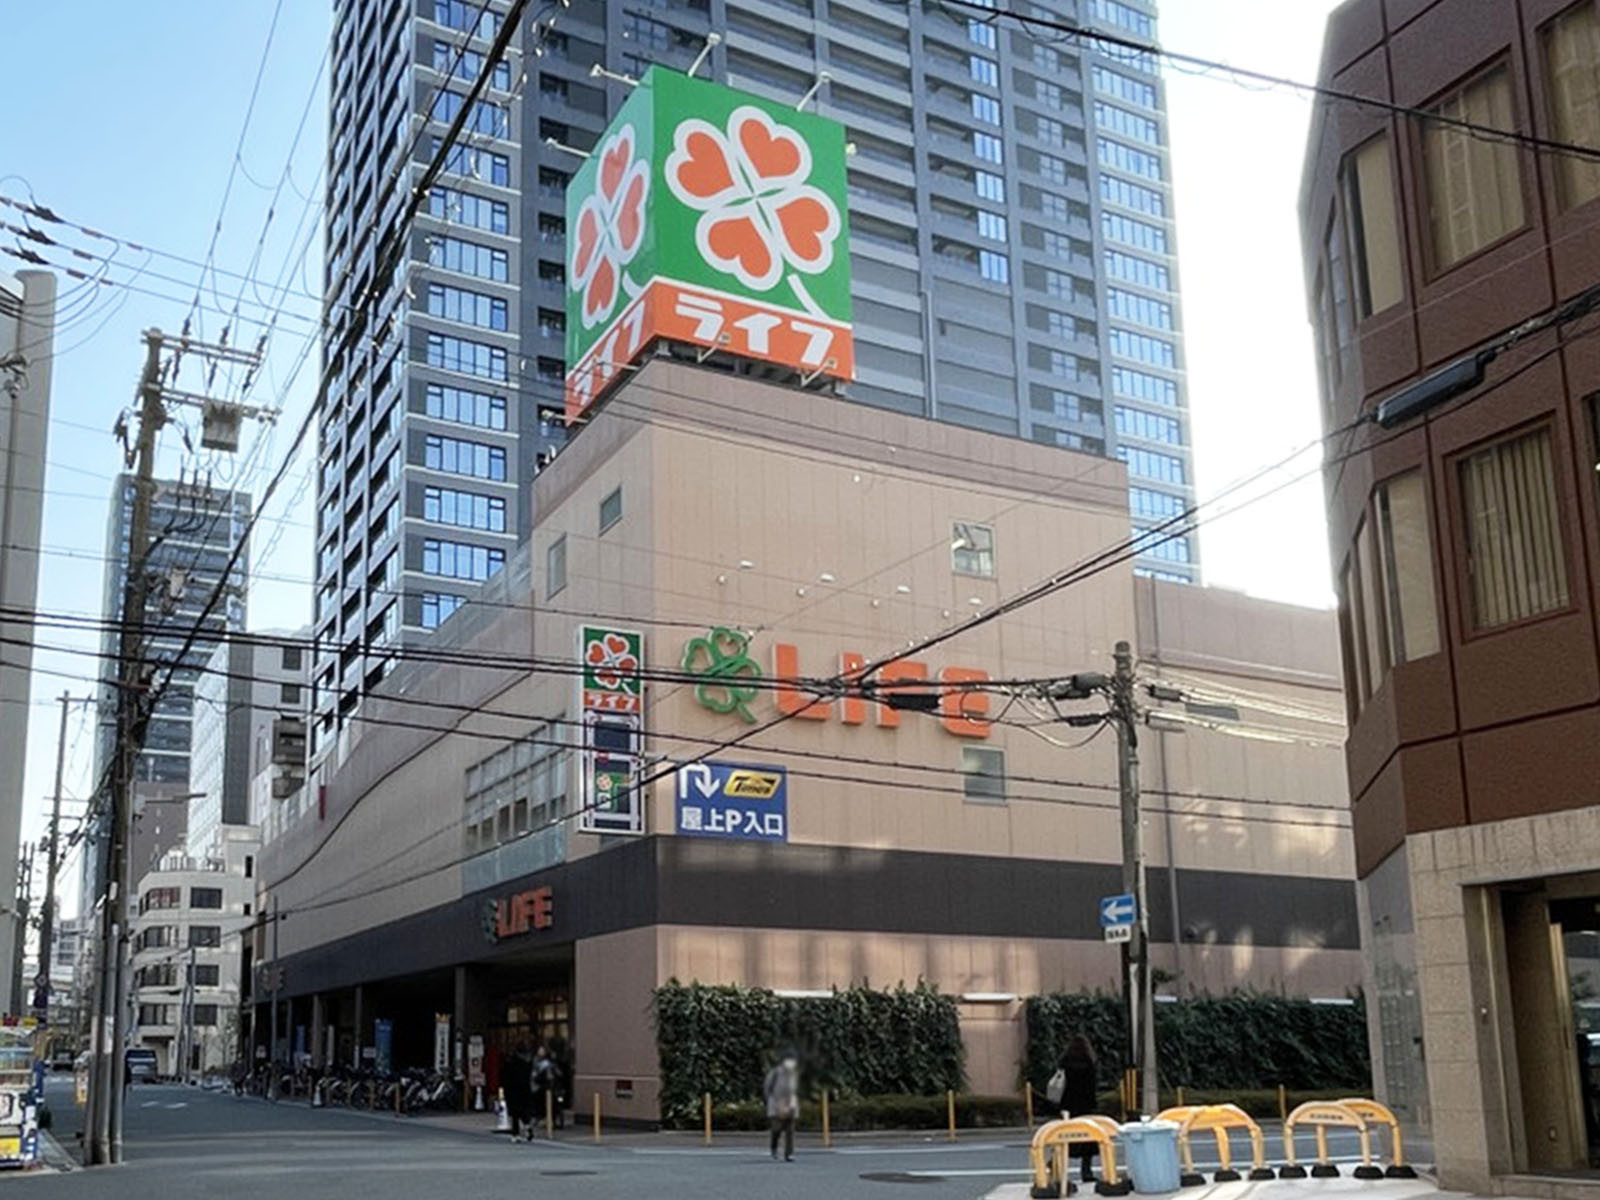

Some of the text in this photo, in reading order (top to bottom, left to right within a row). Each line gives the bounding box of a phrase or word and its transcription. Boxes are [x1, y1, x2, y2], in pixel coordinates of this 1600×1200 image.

[676, 293, 834, 366] ライフ
[772, 642, 991, 739] LIFE
[681, 806, 783, 836] 屋上P入口
[496, 886, 552, 938] LIFE
